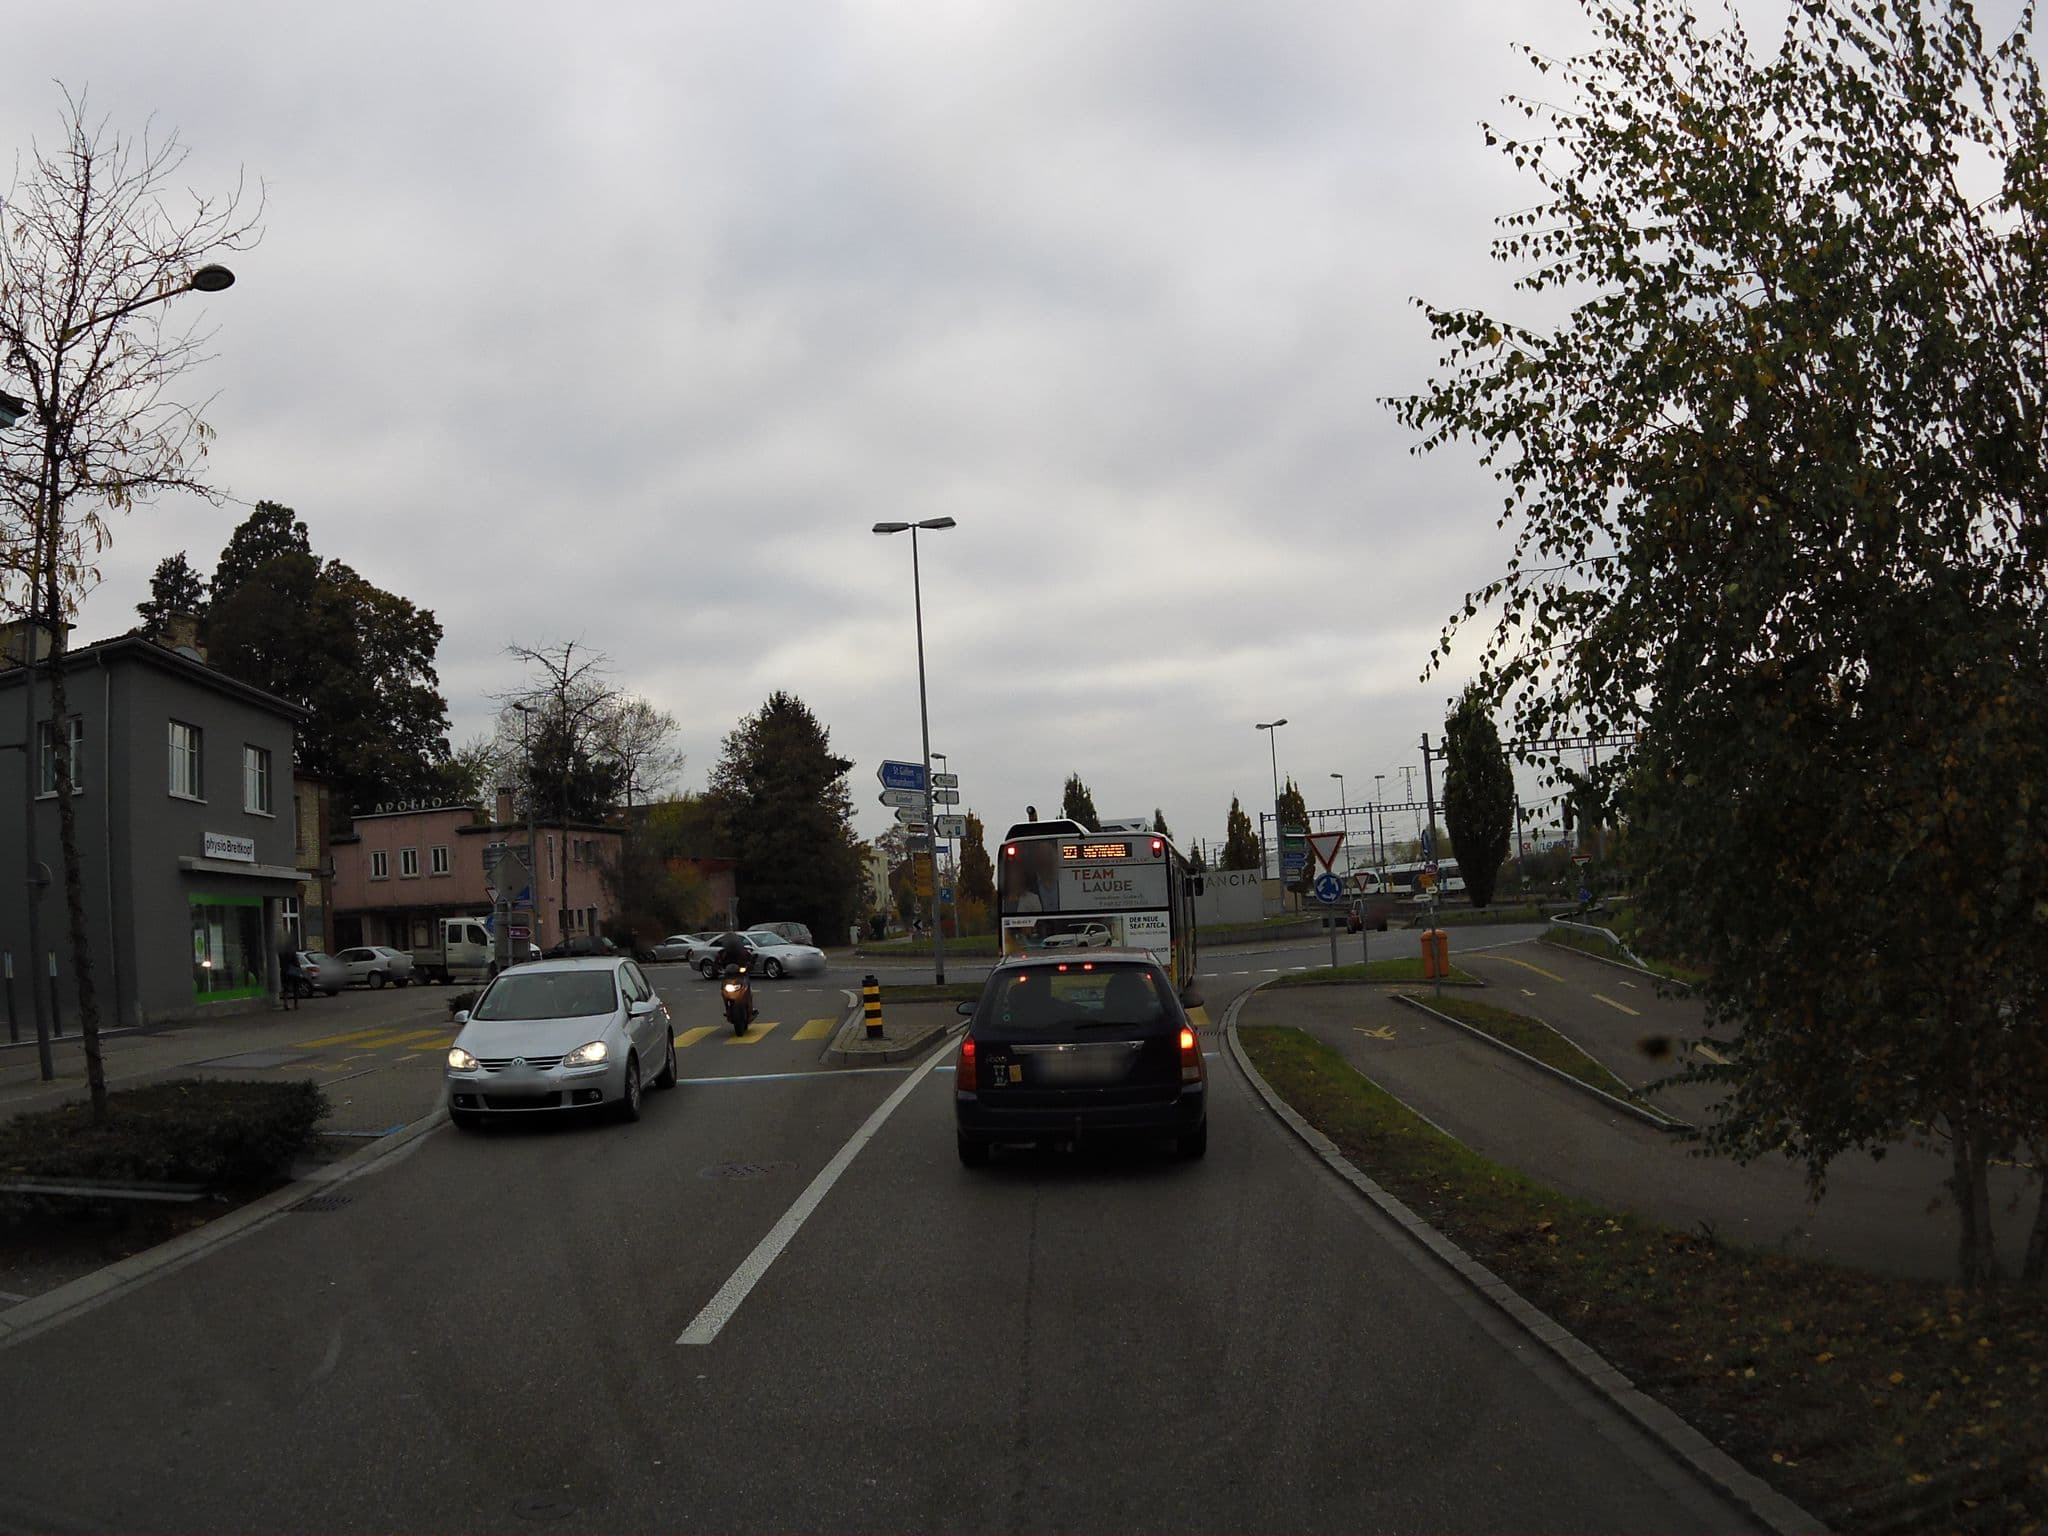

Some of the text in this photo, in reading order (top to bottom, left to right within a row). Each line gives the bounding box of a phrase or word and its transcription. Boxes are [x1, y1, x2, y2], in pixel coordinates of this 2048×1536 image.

[375, 797, 442, 814] APOLLO
[1072, 869, 1114, 880] TEAM
[1082, 881, 1133, 893] LAUBE
[1129, 922, 1144, 930] SEAT
